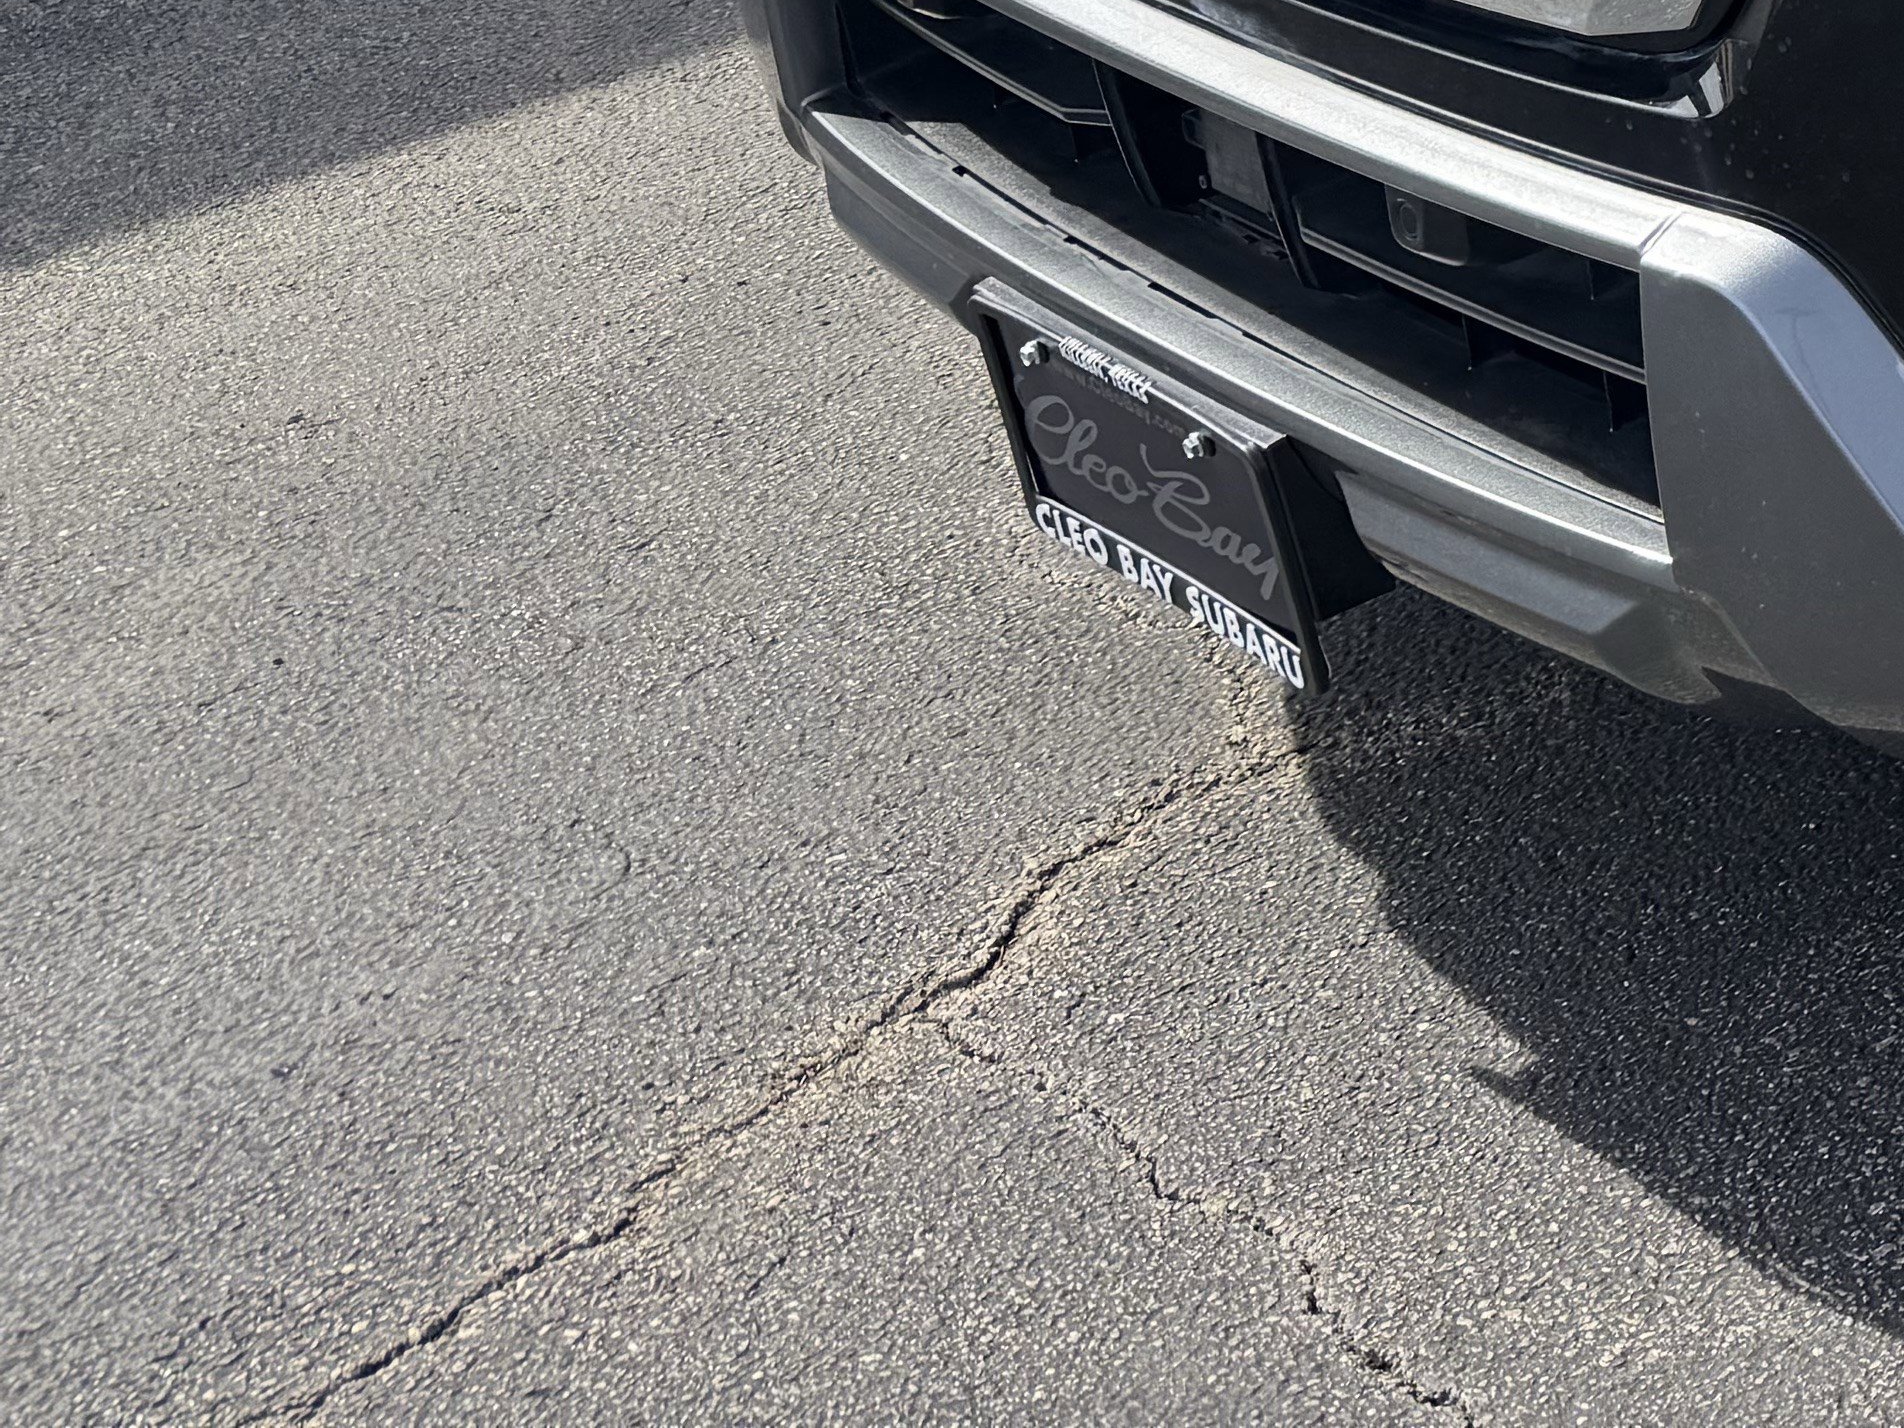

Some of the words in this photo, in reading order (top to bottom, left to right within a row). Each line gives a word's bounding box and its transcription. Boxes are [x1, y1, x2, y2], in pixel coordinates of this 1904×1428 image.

[1025, 395, 1149, 504] Cleo
[1139, 443, 1281, 600] Bay
[1036, 503, 1109, 566] CLEO
[1116, 543, 1174, 604] BAY
[1185, 585, 1305, 689] SUBARU
